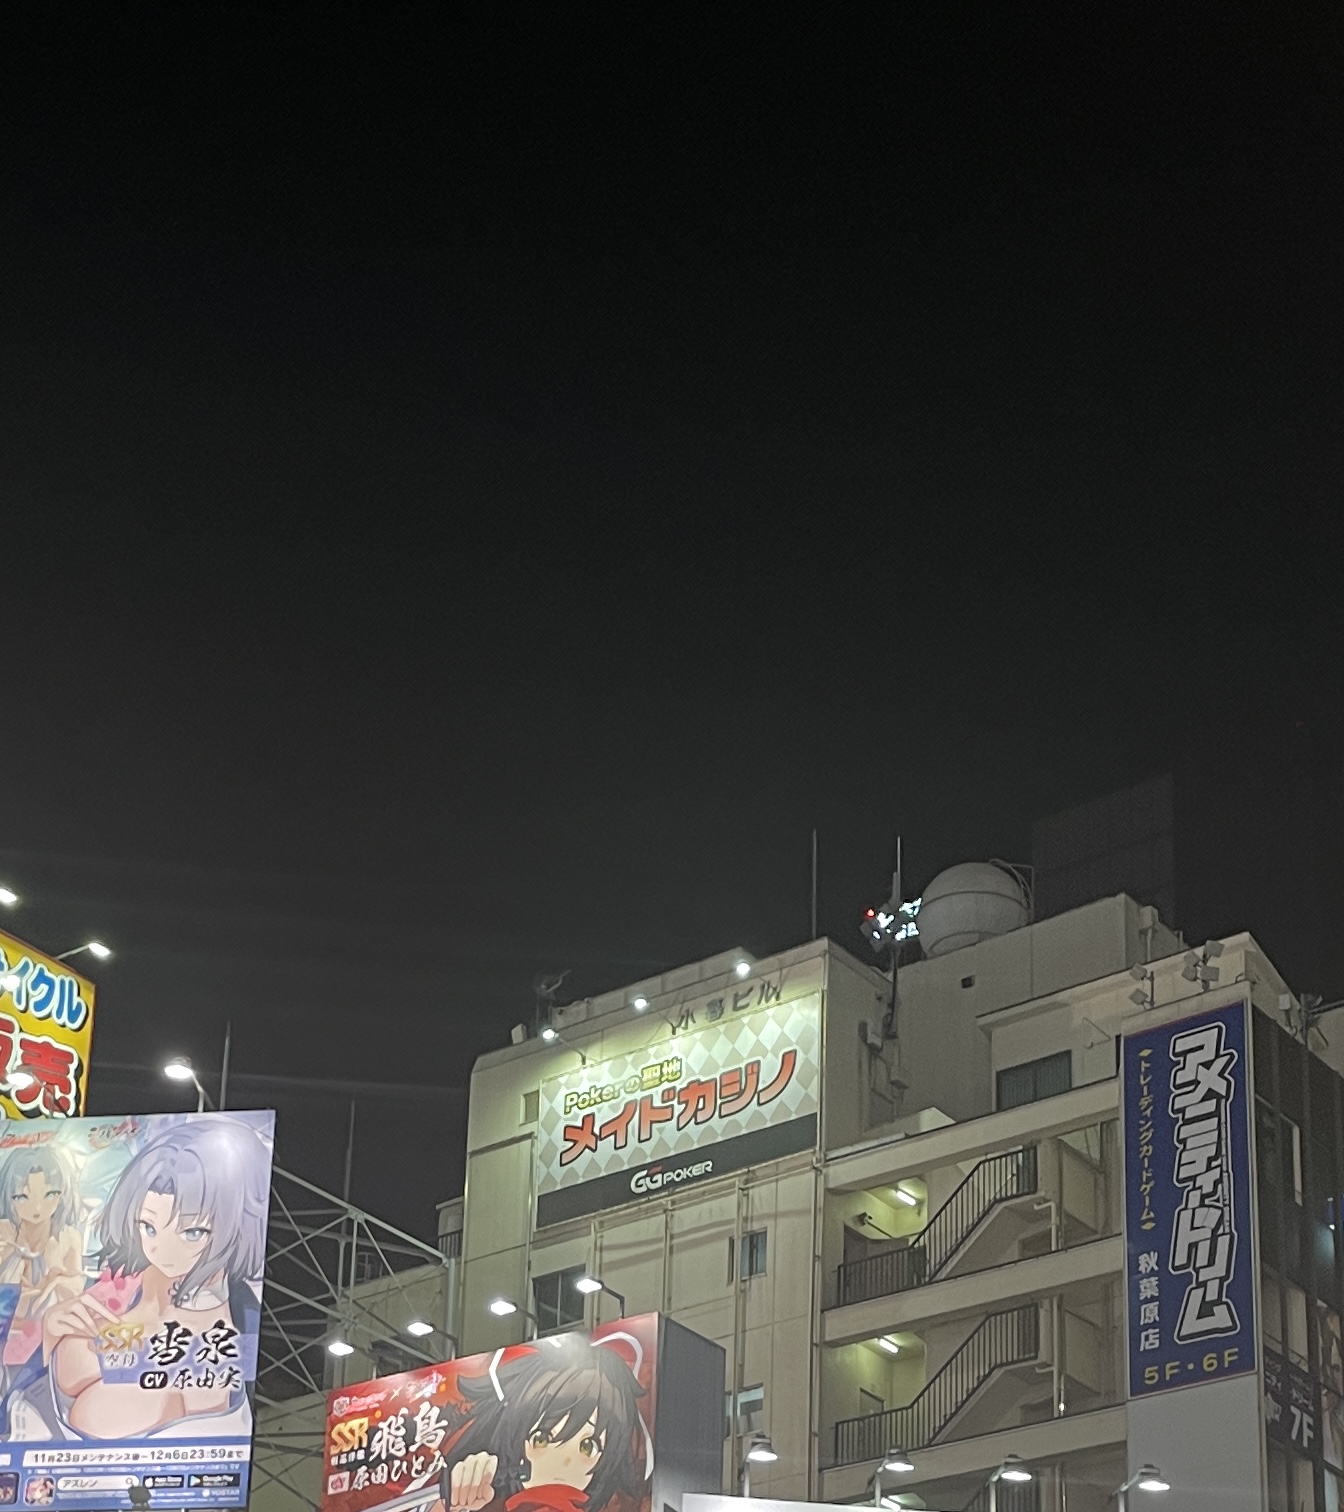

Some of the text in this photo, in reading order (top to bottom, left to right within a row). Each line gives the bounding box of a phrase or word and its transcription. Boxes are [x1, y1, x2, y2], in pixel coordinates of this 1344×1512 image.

[560, 1050, 797, 1167] メイドカジノ
[1139, 1061, 1155, 1221] トレーディングカードゲーム
[1170, 1023, 1239, 1343] アメニティドリーム
[1138, 1251, 1160, 1352] 秋葉原店
